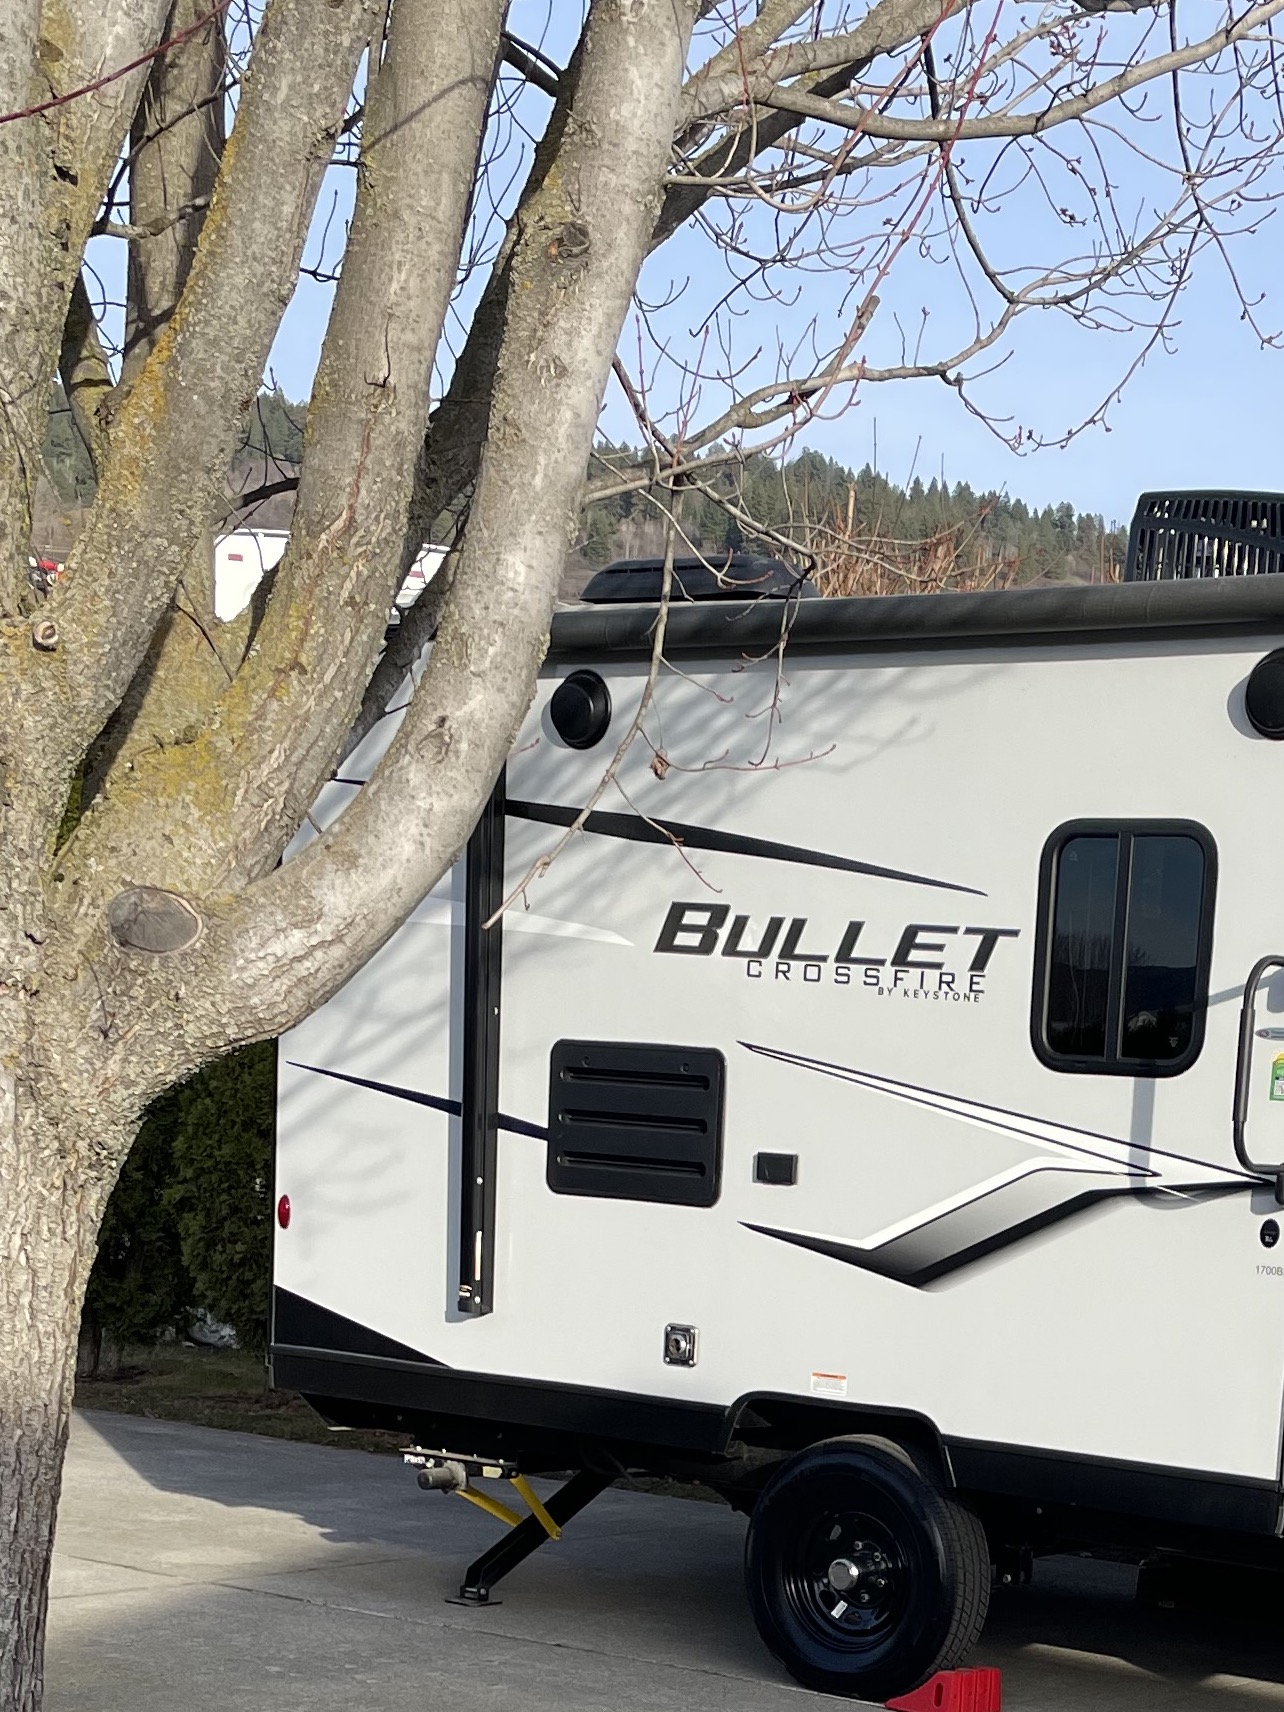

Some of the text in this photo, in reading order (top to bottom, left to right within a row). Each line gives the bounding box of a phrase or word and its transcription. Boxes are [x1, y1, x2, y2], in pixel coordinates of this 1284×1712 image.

[653, 900, 1021, 974] BULLET
[746, 959, 986, 994] CROSSFIRE
[877, 986, 981, 1004] BY KEYSTONE
